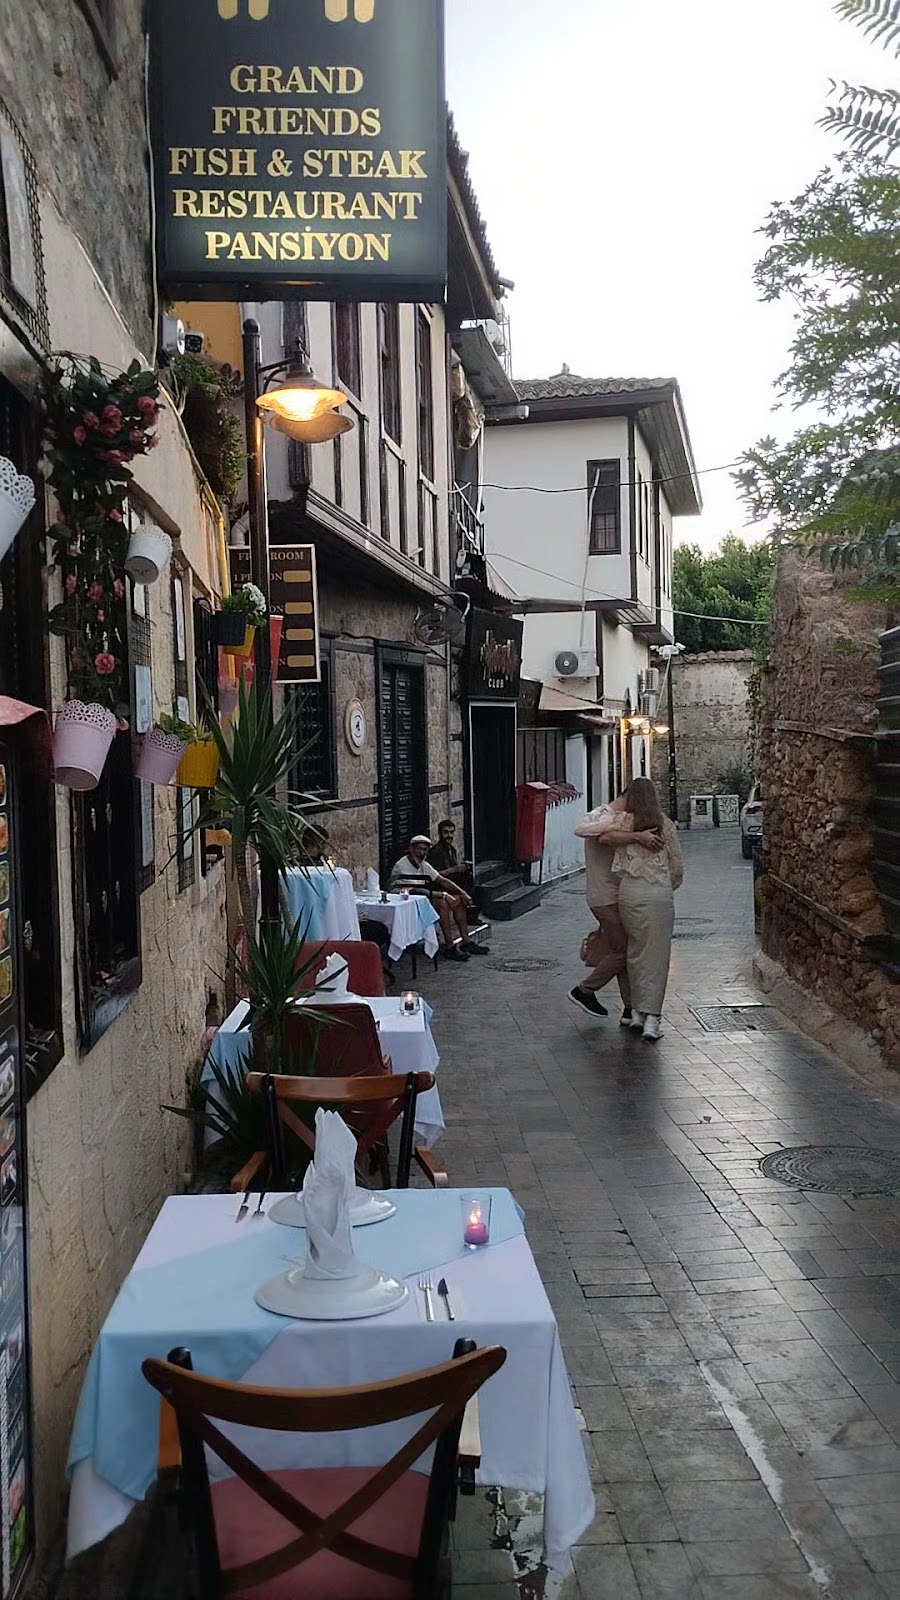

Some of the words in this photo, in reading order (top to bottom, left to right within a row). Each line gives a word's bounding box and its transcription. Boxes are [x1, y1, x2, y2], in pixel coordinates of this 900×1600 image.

[230, 65, 363, 94] GRAND
[212, 107, 381, 136] FRIENDS
[168, 147, 257, 176] FISH
[267, 149, 293, 177] &
[303, 150, 427, 179] STEAK
[173, 189, 423, 220] RESTAURANT
[205, 226, 391, 261] PANSİYON
[270, 551, 304, 561] ROOM
